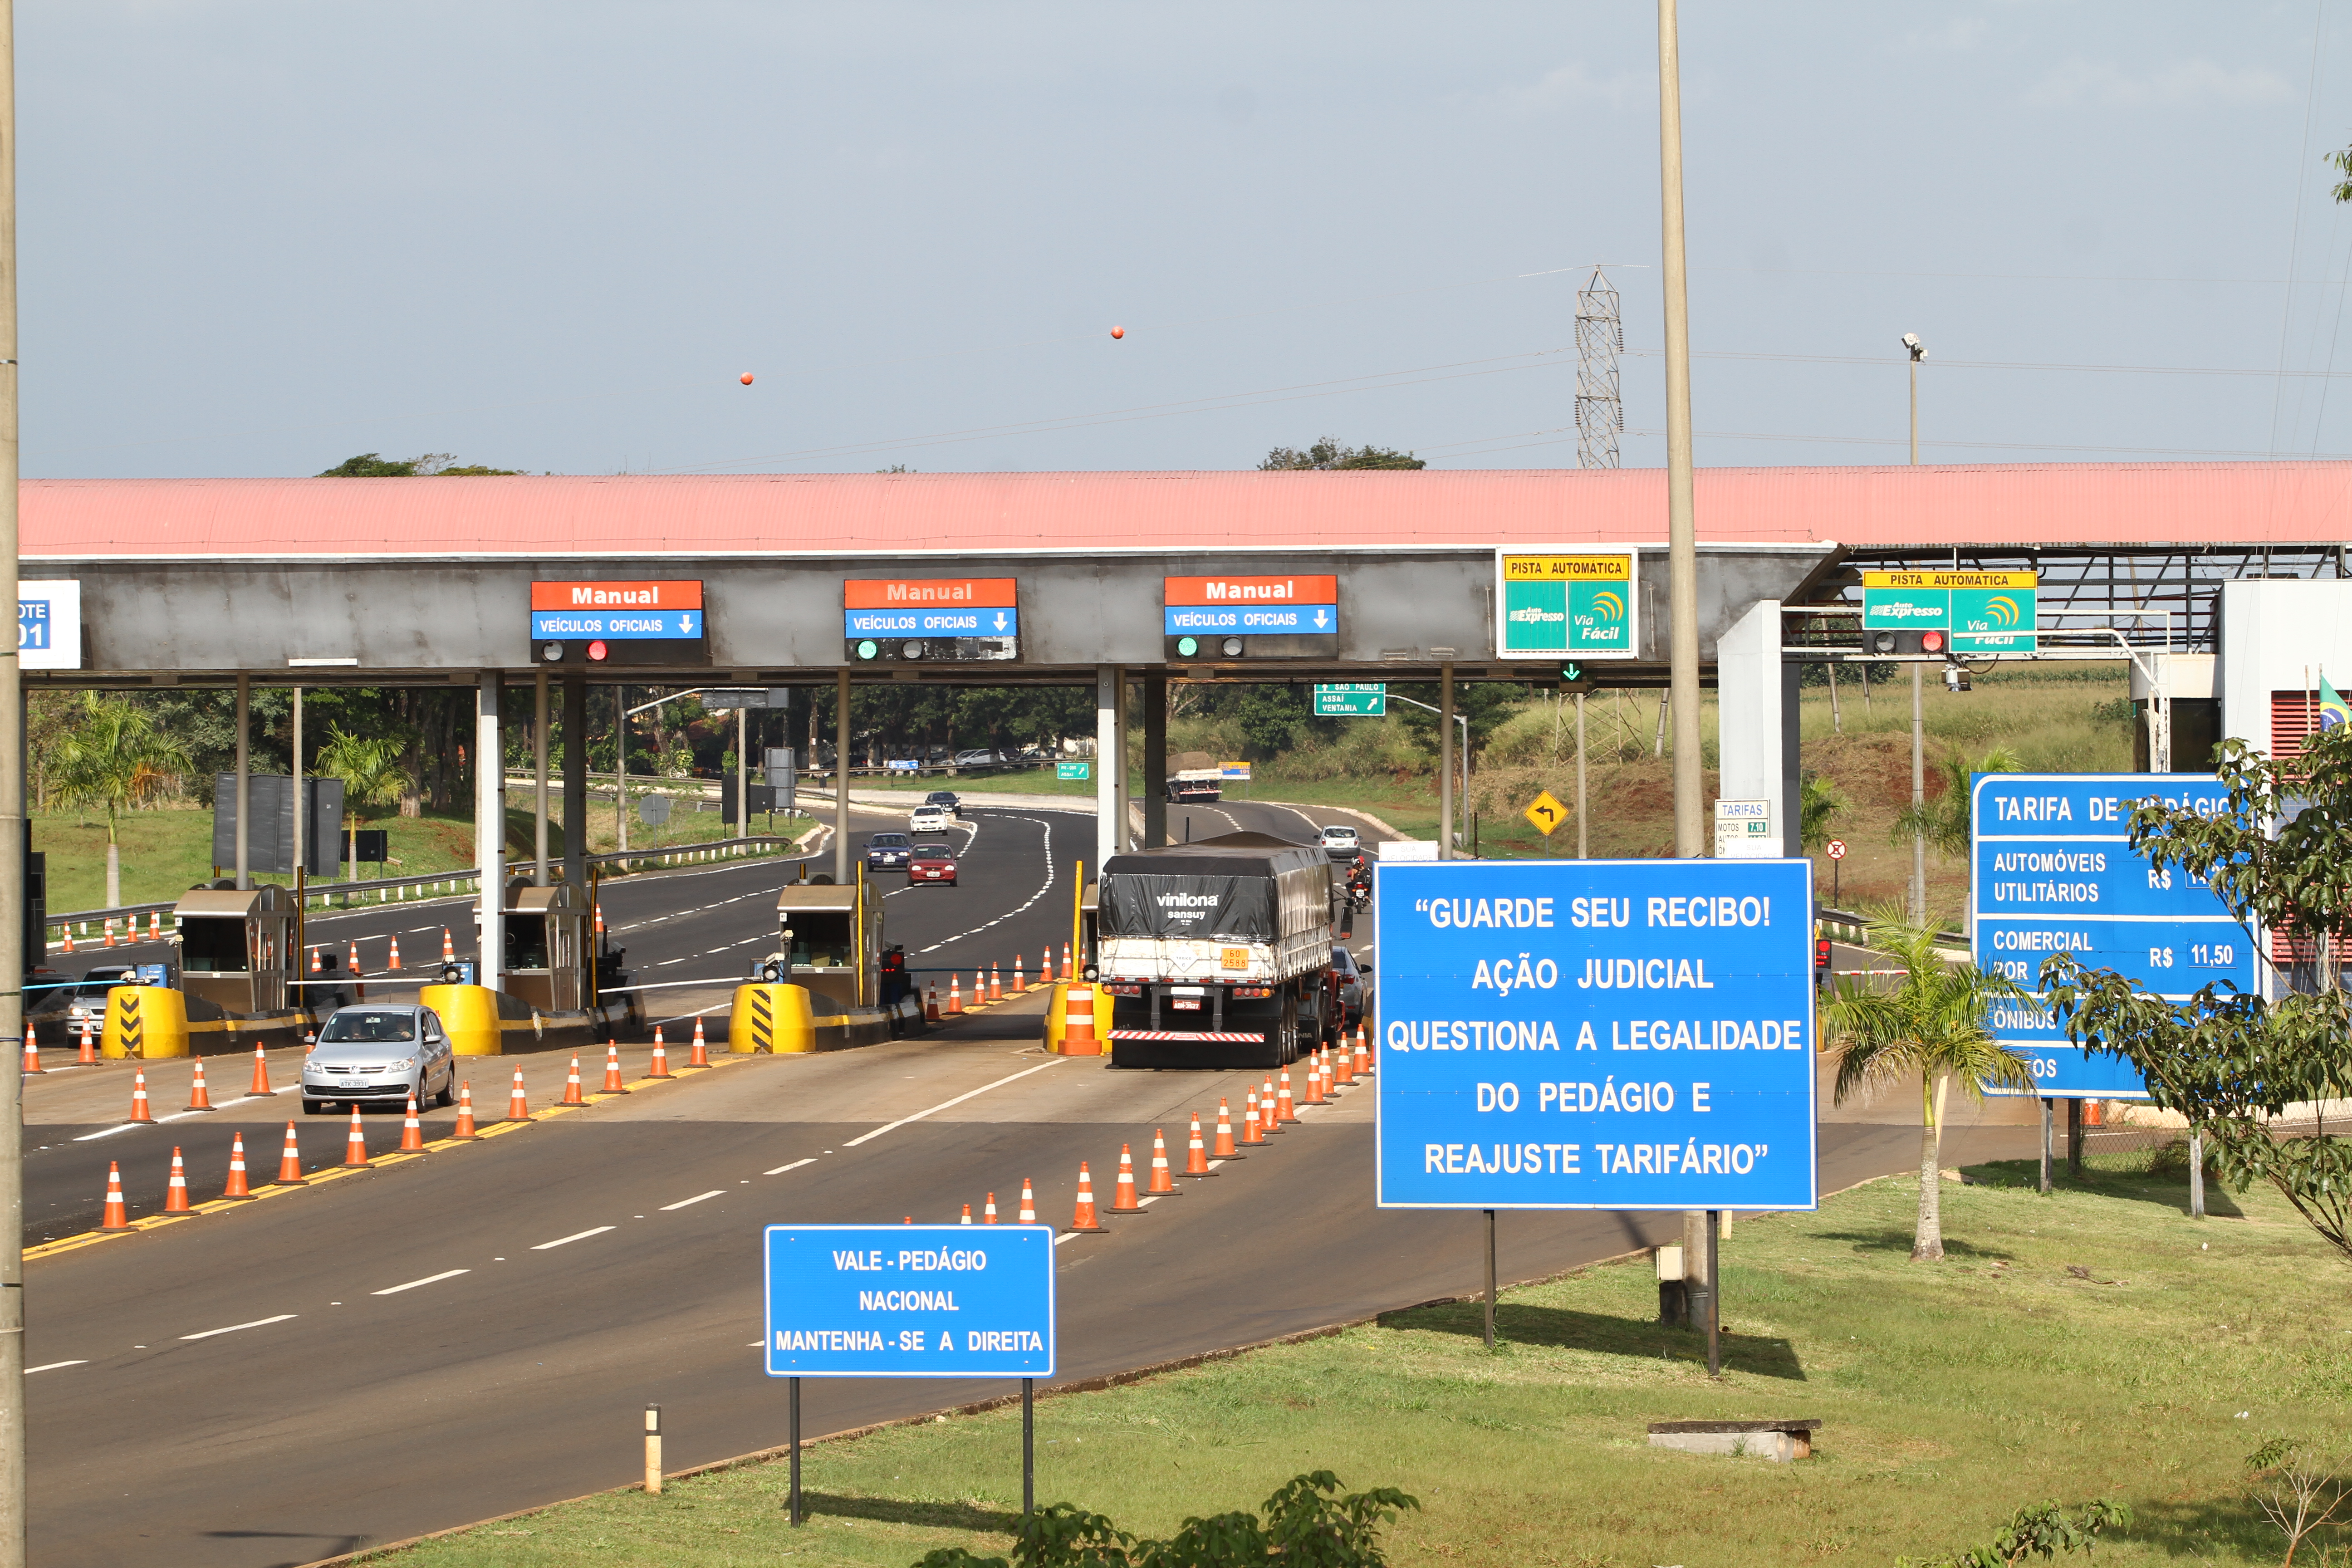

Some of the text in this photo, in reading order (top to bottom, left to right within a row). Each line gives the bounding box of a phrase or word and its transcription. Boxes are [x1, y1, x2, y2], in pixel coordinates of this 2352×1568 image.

[1511, 560, 1622, 574] PISTA AUTOMÁTICA
[1890, 573, 2009, 585] PISTA AUTOMÁTICA
[572, 586, 658, 604] Manual
[887, 583, 972, 601] Manual
[1206, 580, 1293, 599] Manual
[1174, 612, 1298, 627] VEÍCULOS OFICIAIS
[1519, 610, 1564, 624] Expresso
[1574, 615, 1594, 626] Via
[1882, 604, 1943, 619] Expresso
[540, 617, 663, 632] VEÍCULOS OFICIAIS
[853, 615, 977, 629] VEÍCULOS OFICIAIS
[1967, 620, 1988, 632] Via
[1582, 627, 1619, 640] Fácil
[1322, 694, 1344, 702] ASSAÍ
[1722, 804, 1762, 816] TARIFAS
[1994, 797, 2073, 821] TARIFA
[2089, 797, 2118, 821] DE
[1718, 823, 1739, 832] MOTOS
[1994, 849, 2106, 872] AUTOMÓVEIS
[2148, 869, 2171, 890] R$
[1156, 892, 1218, 907] vinilona
[1994, 879, 2099, 902] UTILITÁRIOS
[1167, 911, 1205, 920] sansuy
[1571, 897, 1630, 928] SEU
[1648, 896, 1770, 927] RECIBO!
[1994, 931, 2093, 951] COMERCIAL
[1224, 959, 1246, 967] 2588
[2150, 944, 2233, 968] R$ 11,50
[1472, 952, 1714, 997] AÇÃO JUDICIAL
[1993, 961, 2029, 980] POR
[1994, 1005, 2058, 1030] ÔNIBUS
[1387, 1020, 1802, 1053] QUESTIONA A LEGALIDADE
[1477, 1075, 1711, 1112] DO PEDÁGIO E
[1425, 1143, 1581, 1174] REAJUSTE
[860, 1291, 959, 1311] NACIONAL
[939, 1331, 954, 1351] A
[968, 1331, 1044, 1351] DIREITA
